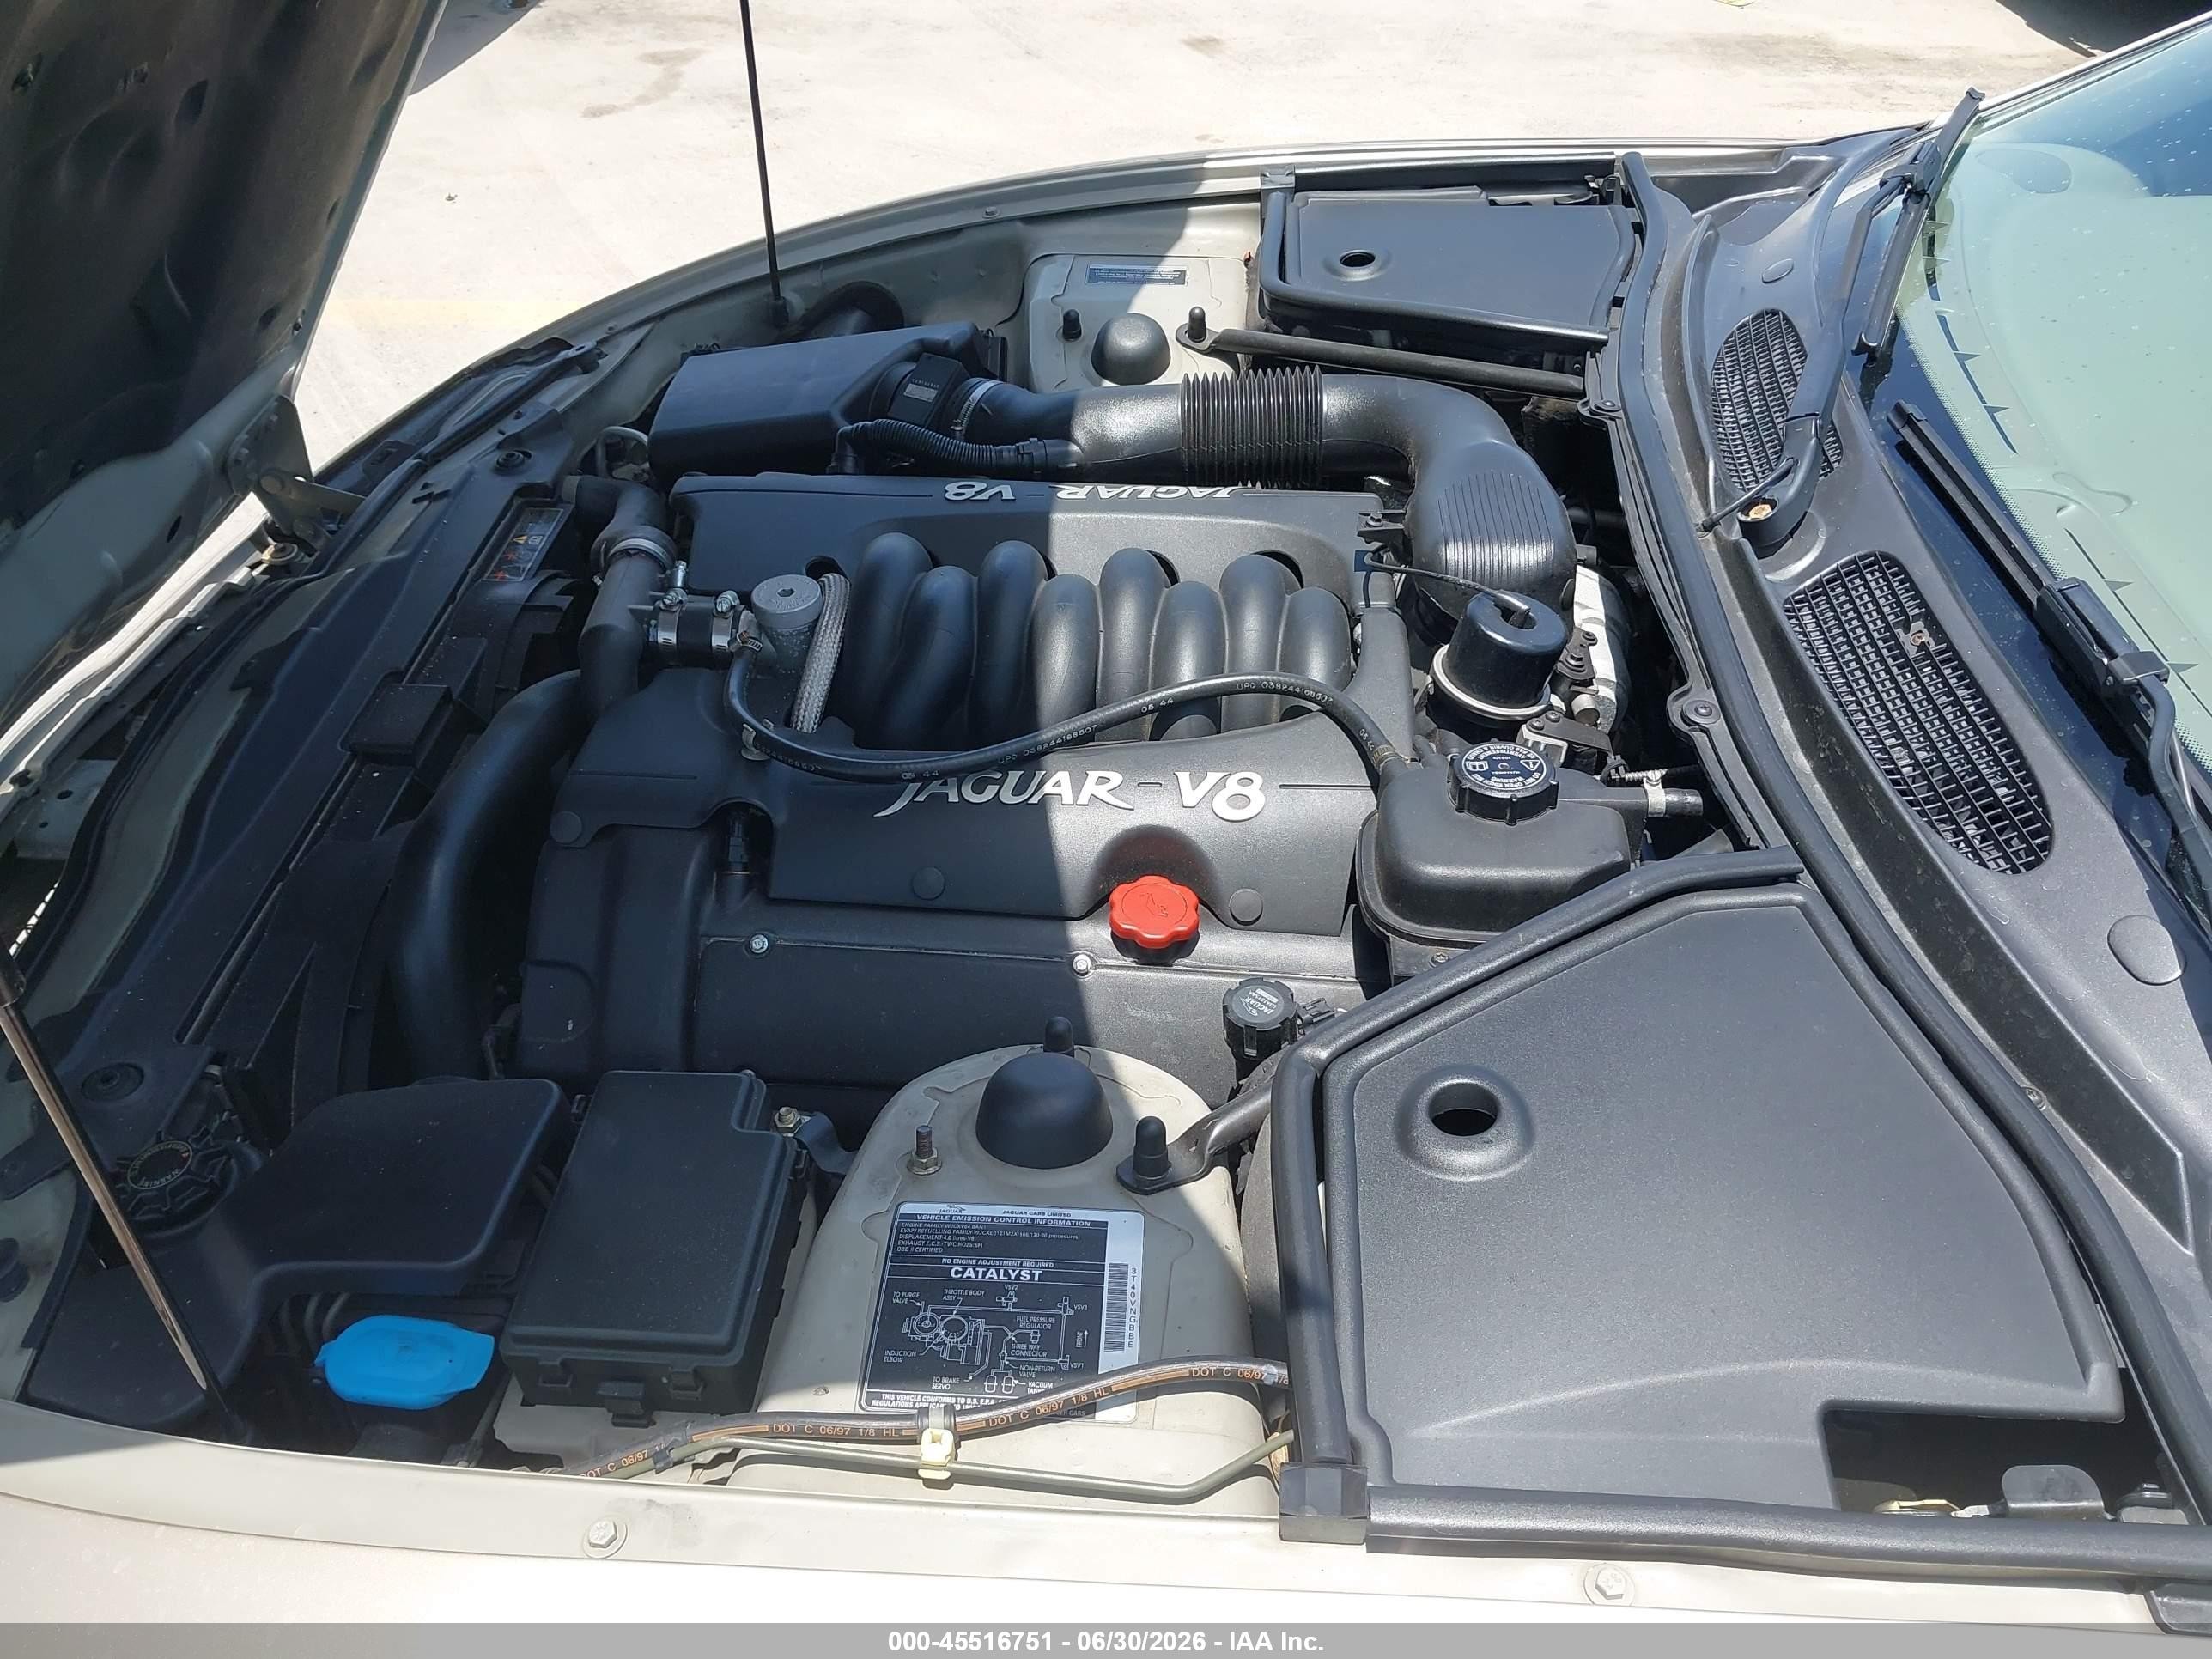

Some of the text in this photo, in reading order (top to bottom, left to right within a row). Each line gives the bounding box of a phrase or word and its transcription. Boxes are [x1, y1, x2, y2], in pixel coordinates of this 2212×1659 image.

[945, 481, 1245, 501] JAGUAR V8
[873, 770, 1267, 823] JAGUAR V8
[1244, 996, 1275, 1015] JAGUAR
[1034, 1218, 1091, 1227] INFORMATION
[950, 1267, 1043, 1281] CATALYST
[1010, 1350, 1048, 1358] CONNECTOR
[1019, 1364, 1056, 1373] NON-RETURN
[1193, 1367, 1217, 1377] DOT
[1223, 1367, 1231, 1376] C
[1028, 1381, 1054, 1389] VACUUM
[871, 1400, 913, 1408] REGULATIONS
[989, 1414, 1012, 1427] DOT
[1020, 1410, 1030, 1419] C
[1035, 1400, 1065, 1416] 06/97
[1071, 1393, 1087, 1405] 1/8
[1094, 1386, 1109, 1398] HL
[773, 1424, 796, 1433] DOT
[804, 1425, 813, 1434] C
[819, 1426, 851, 1436] 06/97
[607, 1462, 617, 1472] C
